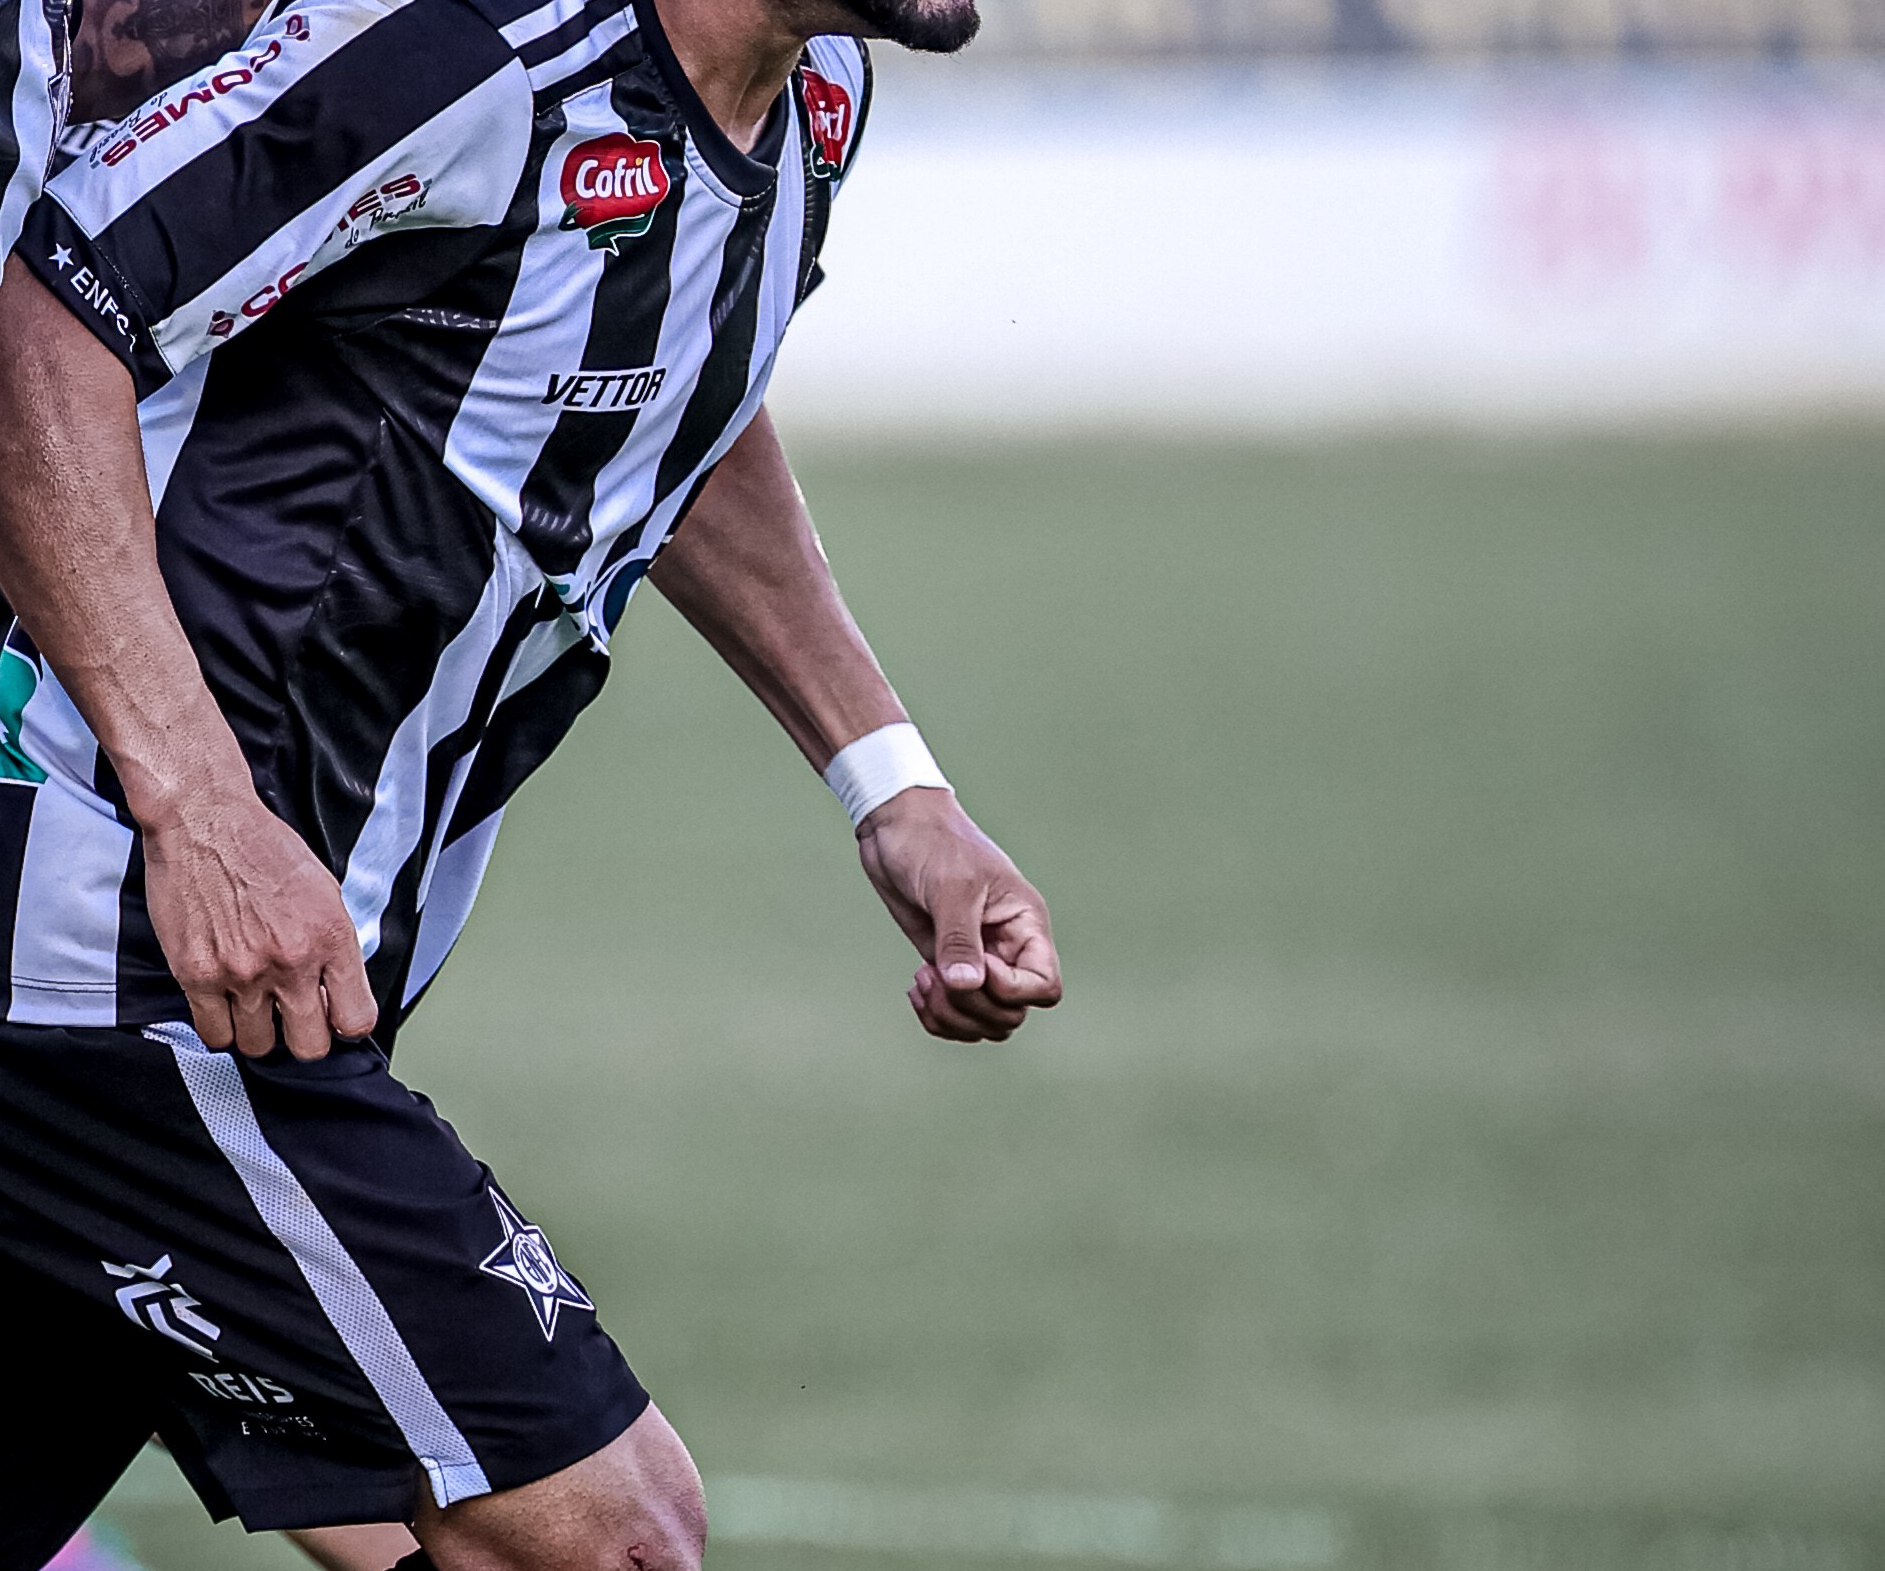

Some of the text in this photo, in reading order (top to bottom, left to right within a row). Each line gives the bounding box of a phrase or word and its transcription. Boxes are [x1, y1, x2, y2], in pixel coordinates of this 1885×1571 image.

[575, 157, 659, 198] Cofril
[70, 266, 129, 336] ENFC
[541, 367, 666, 408] VETTOR
[187, 1372, 294, 1404] REIS
